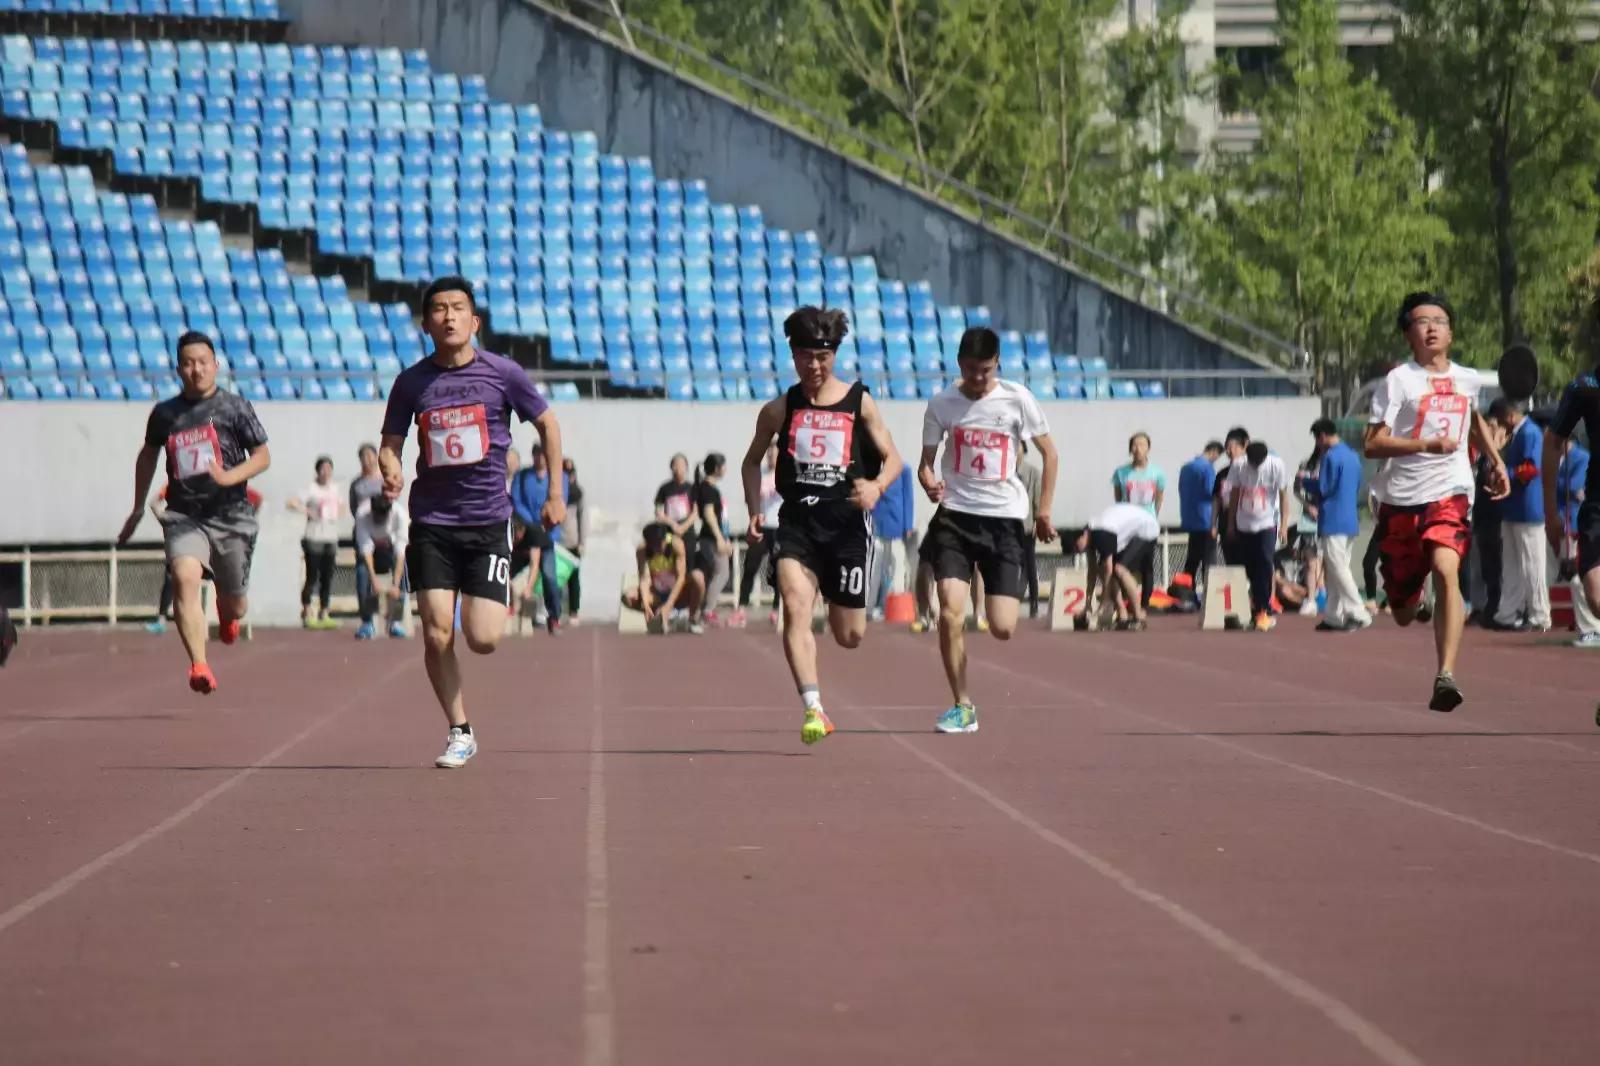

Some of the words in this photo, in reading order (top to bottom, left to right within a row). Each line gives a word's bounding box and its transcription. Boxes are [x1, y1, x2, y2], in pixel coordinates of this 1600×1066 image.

[1435, 417, 1450, 438] 3
[445, 433, 464, 459] 6
[810, 434, 826, 458] 5
[187, 448, 200, 471] 7
[970, 453, 986, 474] 4
[487, 554, 509, 585] 10
[1063, 587, 1086, 615] 2
[1216, 583, 1232, 612] 1
